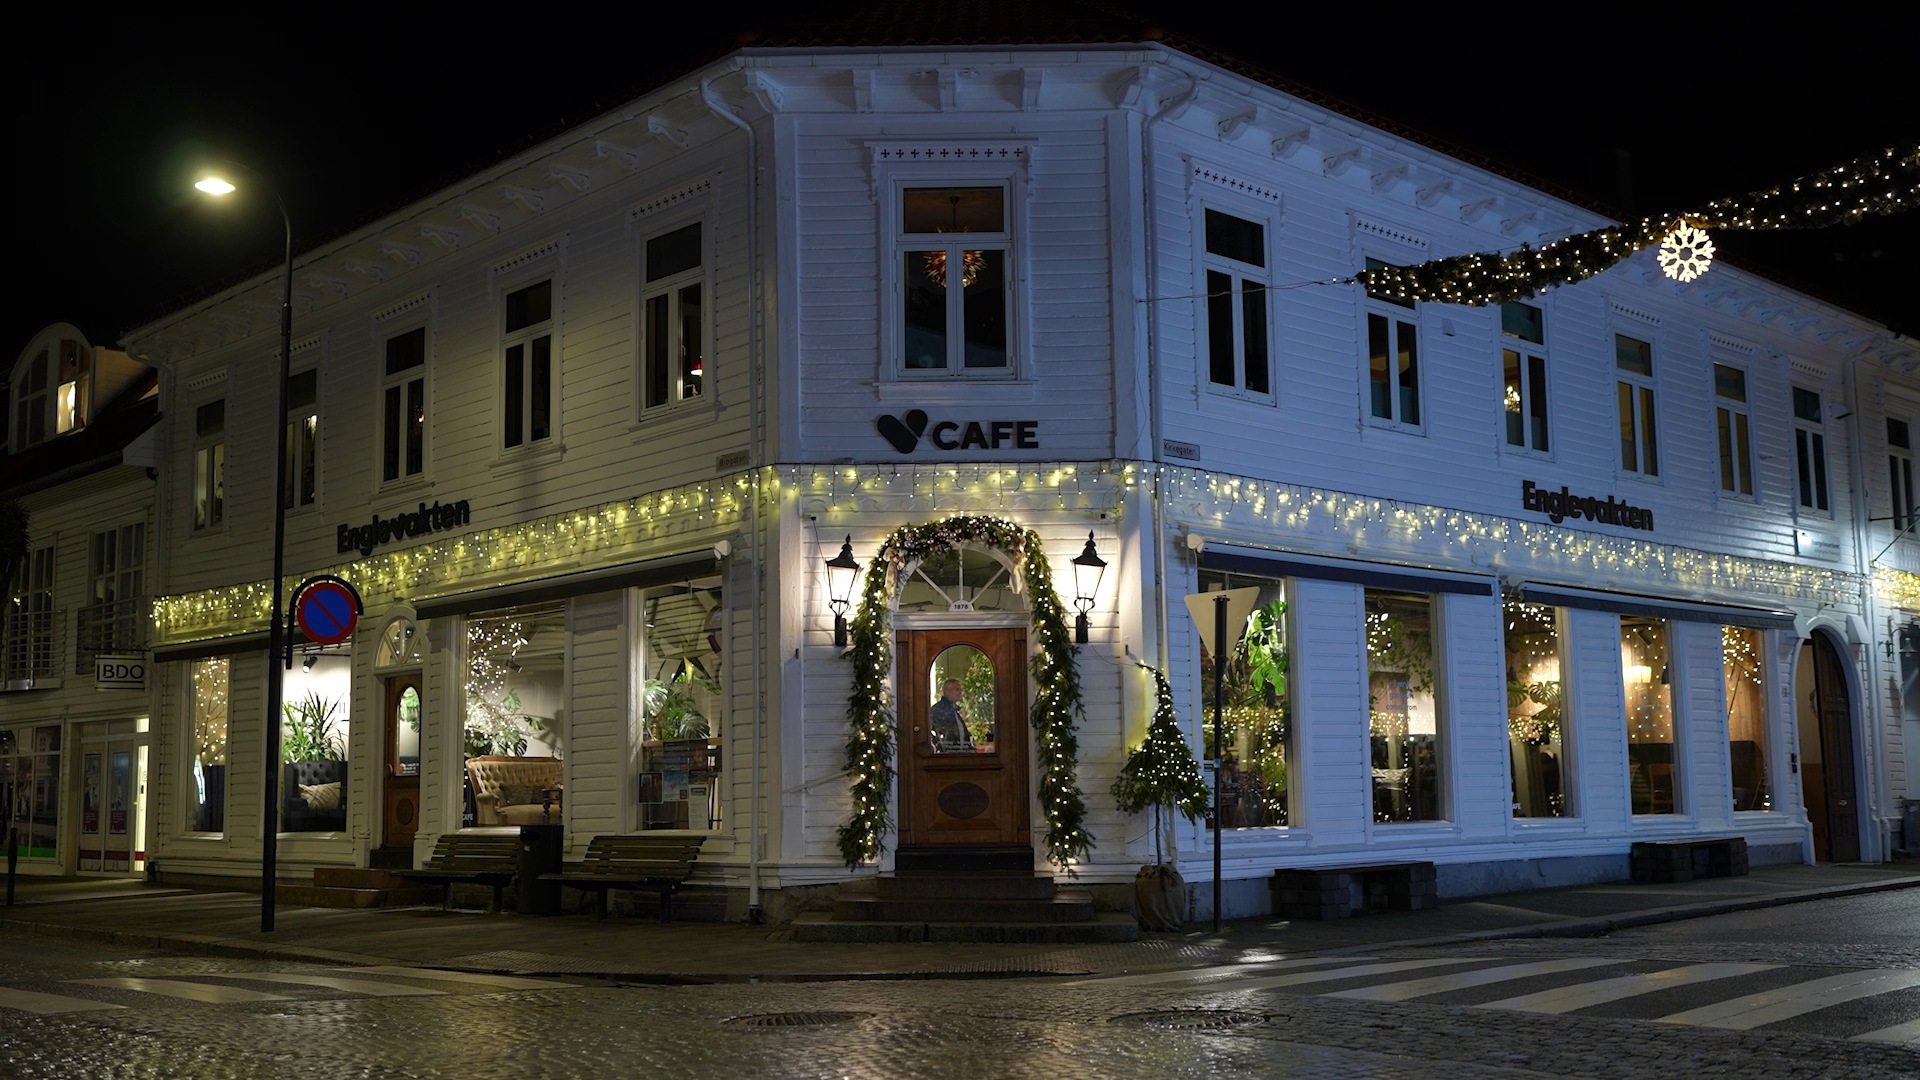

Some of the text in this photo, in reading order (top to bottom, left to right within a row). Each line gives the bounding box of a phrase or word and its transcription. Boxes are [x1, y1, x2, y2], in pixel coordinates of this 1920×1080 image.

[932, 421, 1039, 450] CAFE
[1163, 441, 1196, 455] Kirkegaten
[719, 455, 747, 467] Brogaten
[1523, 480, 1654, 531] Englevakten
[337, 500, 470, 556] Englevakten
[103, 664, 144, 679] BDO
